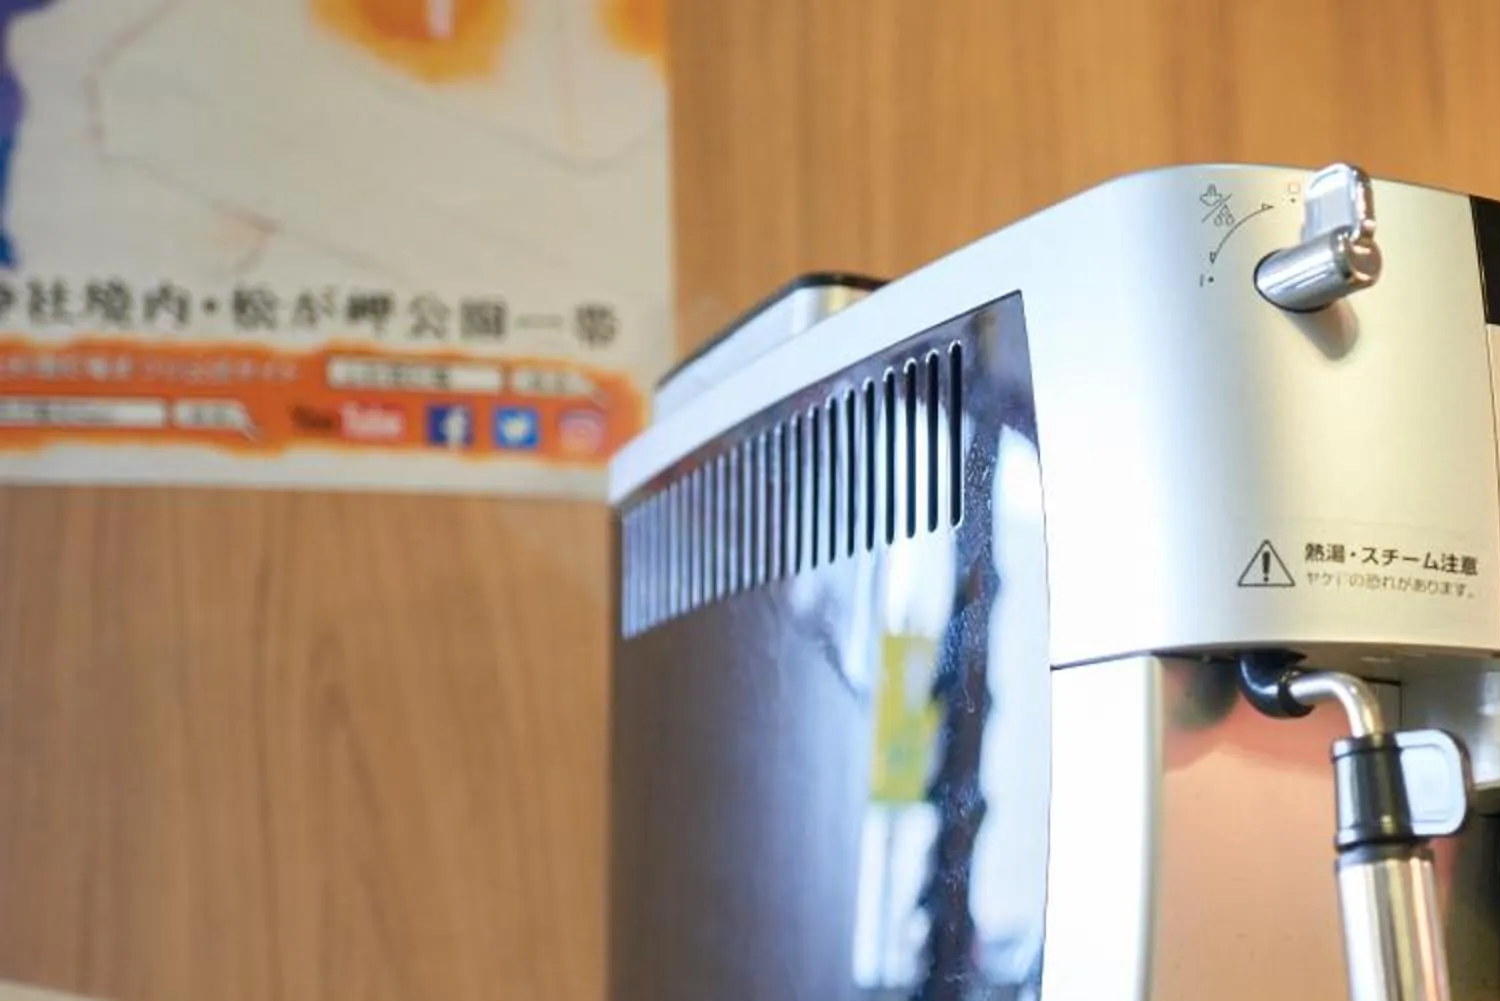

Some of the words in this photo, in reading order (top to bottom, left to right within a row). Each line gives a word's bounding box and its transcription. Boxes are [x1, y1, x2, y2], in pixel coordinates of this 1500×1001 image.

[1305, 541, 1479, 577] 熱湯・スチーム注意
